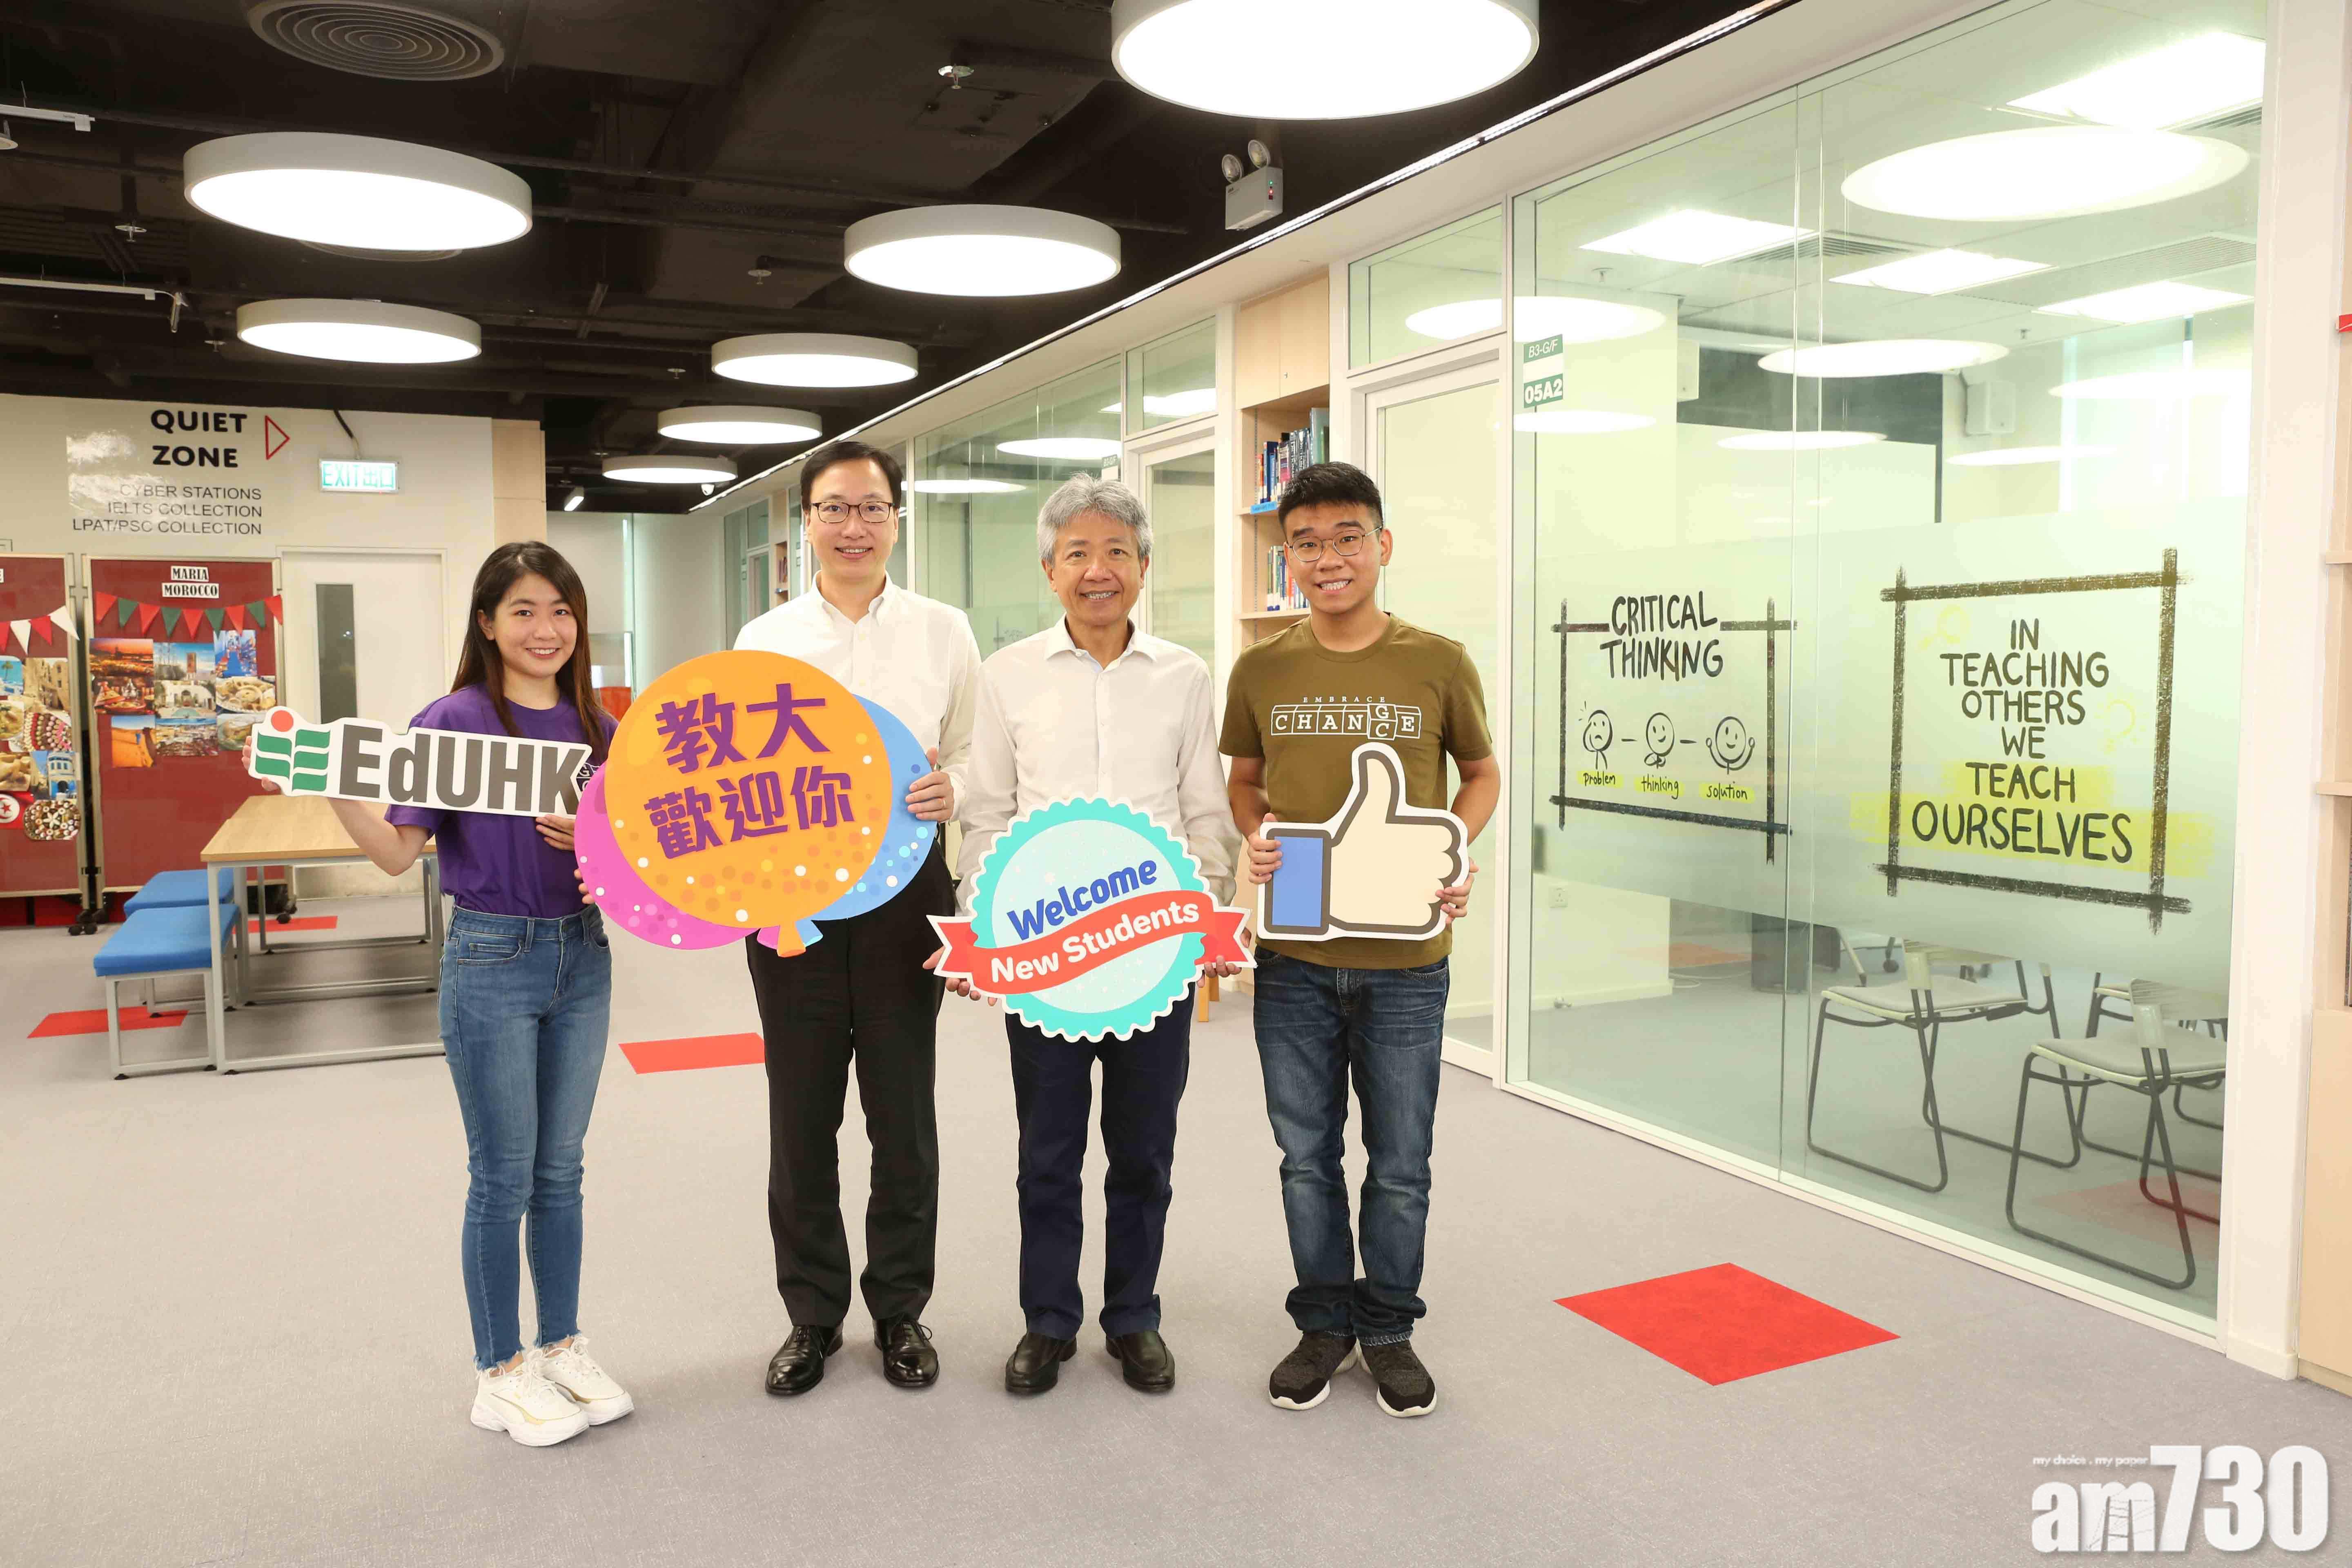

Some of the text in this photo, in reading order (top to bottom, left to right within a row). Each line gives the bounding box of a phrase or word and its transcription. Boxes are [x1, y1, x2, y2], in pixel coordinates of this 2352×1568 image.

[1528, 339, 1558, 358] B3-G/F
[1525, 379, 1563, 404] 05A2
[151, 409, 247, 434] QUIET
[152, 445, 238, 468] ZONE
[323, 463, 359, 486] EXIT
[363, 465, 394, 488] 出口
[120, 484, 262, 500] CYBER STATIONS
[108, 501, 262, 517] IELTS COLLECTION
[73, 519, 261, 535] LPAT/PSC COLLECTION
[173, 568, 207, 580] MARIA
[164, 585, 218, 596] MOROCCO
[1611, 591, 1717, 637] CRITICAL
[2010, 618, 2039, 650] IN
[1599, 637, 1723, 681] THINKING
[1940, 651, 2109, 688] TEACHING
[1961, 689, 2085, 725] OTHERS
[655, 683, 830, 774] 教大
[2001, 726, 2046, 759] WE
[339, 724, 588, 815] EdUHK
[1965, 762, 2076, 803] TEACH
[1641, 774, 1679, 800] thinking
[1706, 782, 1748, 800] solution
[644, 766, 855, 860] 歡迎你
[1912, 800, 2132, 863] OURSELVES
[1007, 860, 1158, 941] Welcome
[991, 901, 1200, 983] New Students
